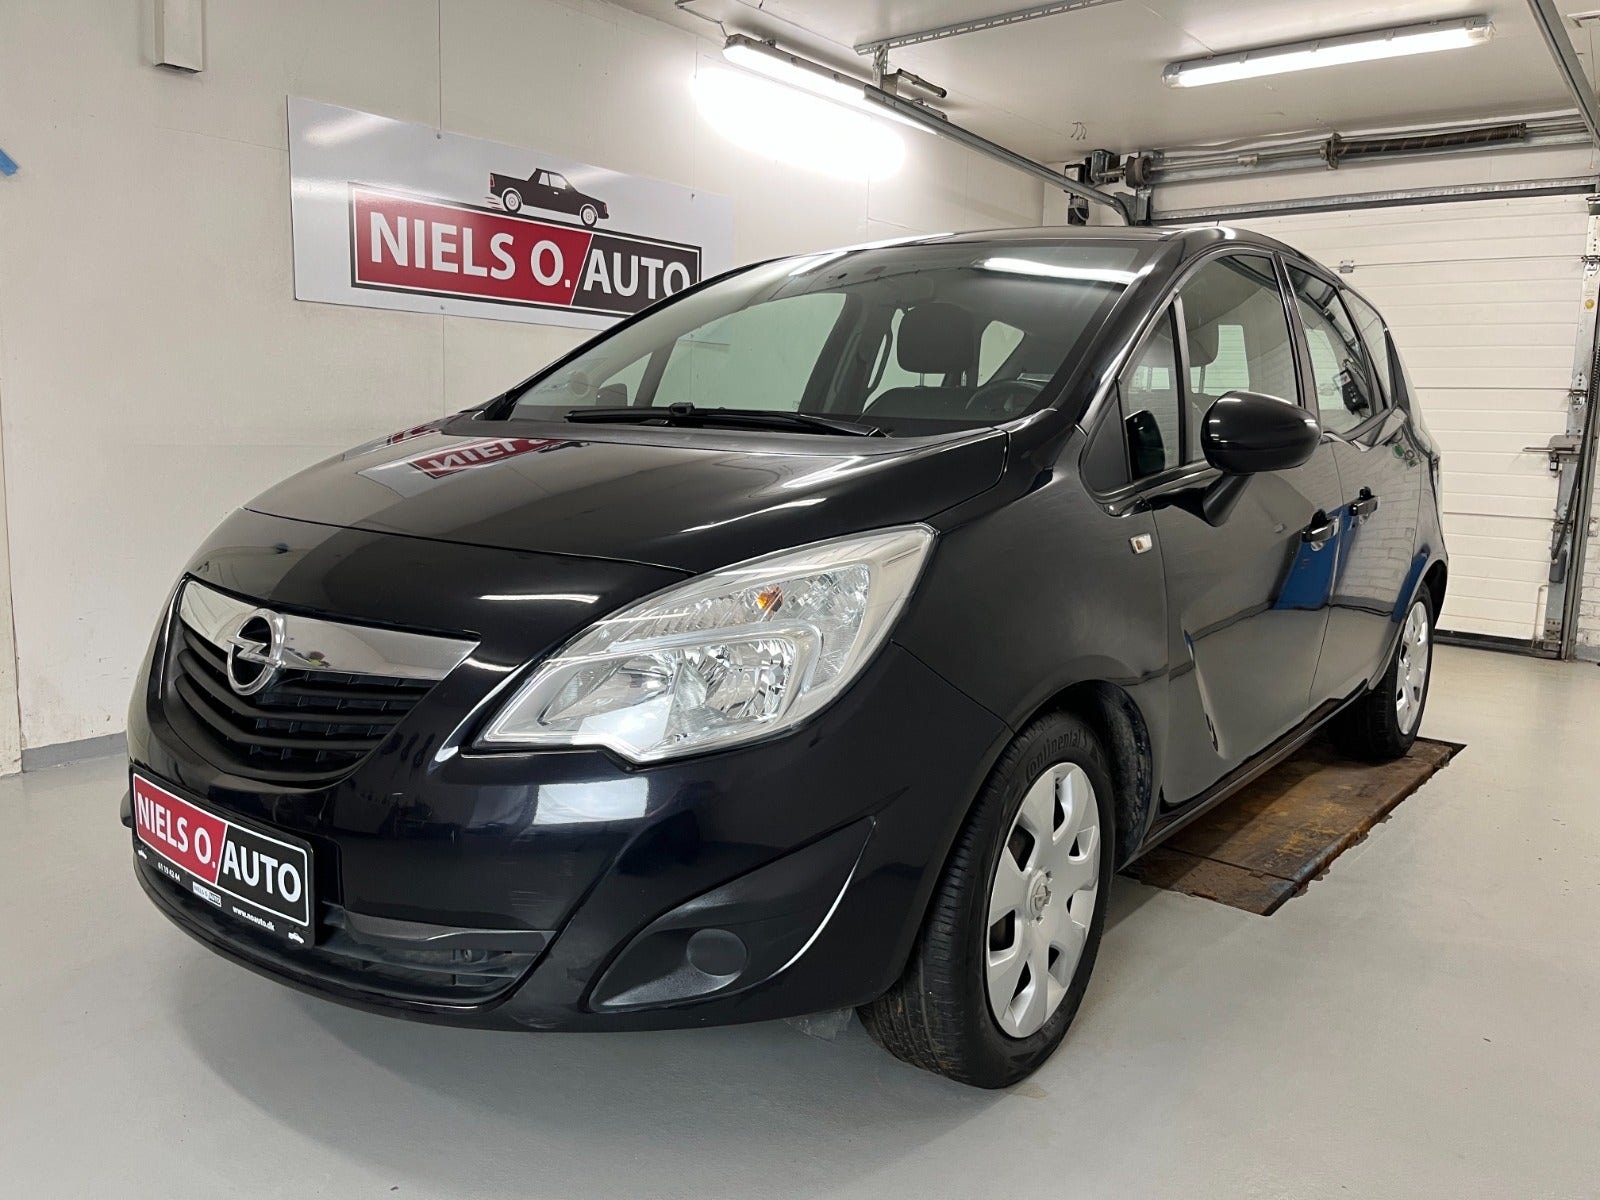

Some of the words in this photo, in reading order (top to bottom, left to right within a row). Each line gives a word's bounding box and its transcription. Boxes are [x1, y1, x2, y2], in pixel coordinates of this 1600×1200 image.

[369, 211, 516, 281] NIELS
[530, 239, 572, 289] O.
[582, 248, 692, 301] AUTO
[1025, 728, 1081, 784] Continental
[136, 791, 189, 854] NIELS
[194, 826, 216, 870] O.
[222, 840, 302, 903] AUTO
